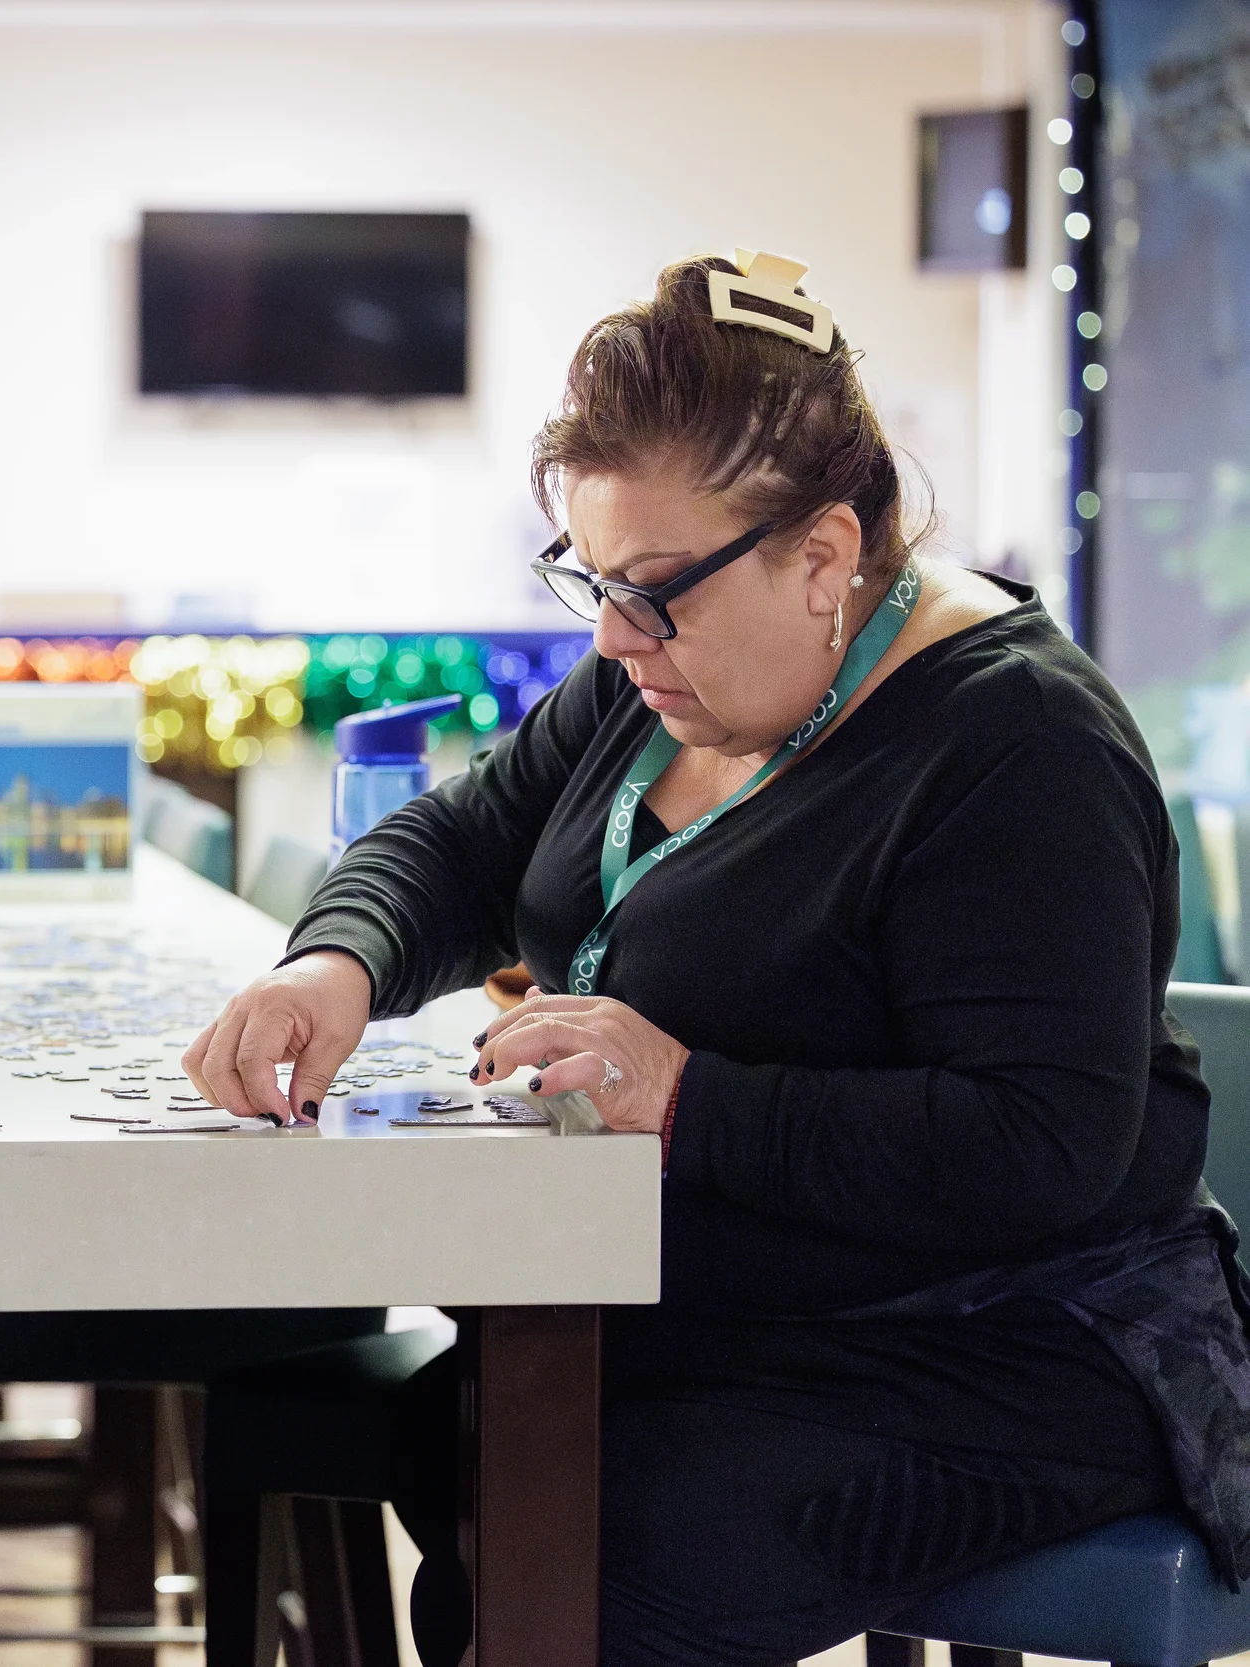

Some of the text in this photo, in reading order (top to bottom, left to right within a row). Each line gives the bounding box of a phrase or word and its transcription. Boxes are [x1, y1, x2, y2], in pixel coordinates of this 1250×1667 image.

[889, 558, 917, 613] OCA
[788, 689, 837, 750] COCA
[612, 782, 649, 848] COCA
[651, 815, 712, 860] COCA
[575, 948, 603, 996] OCA
